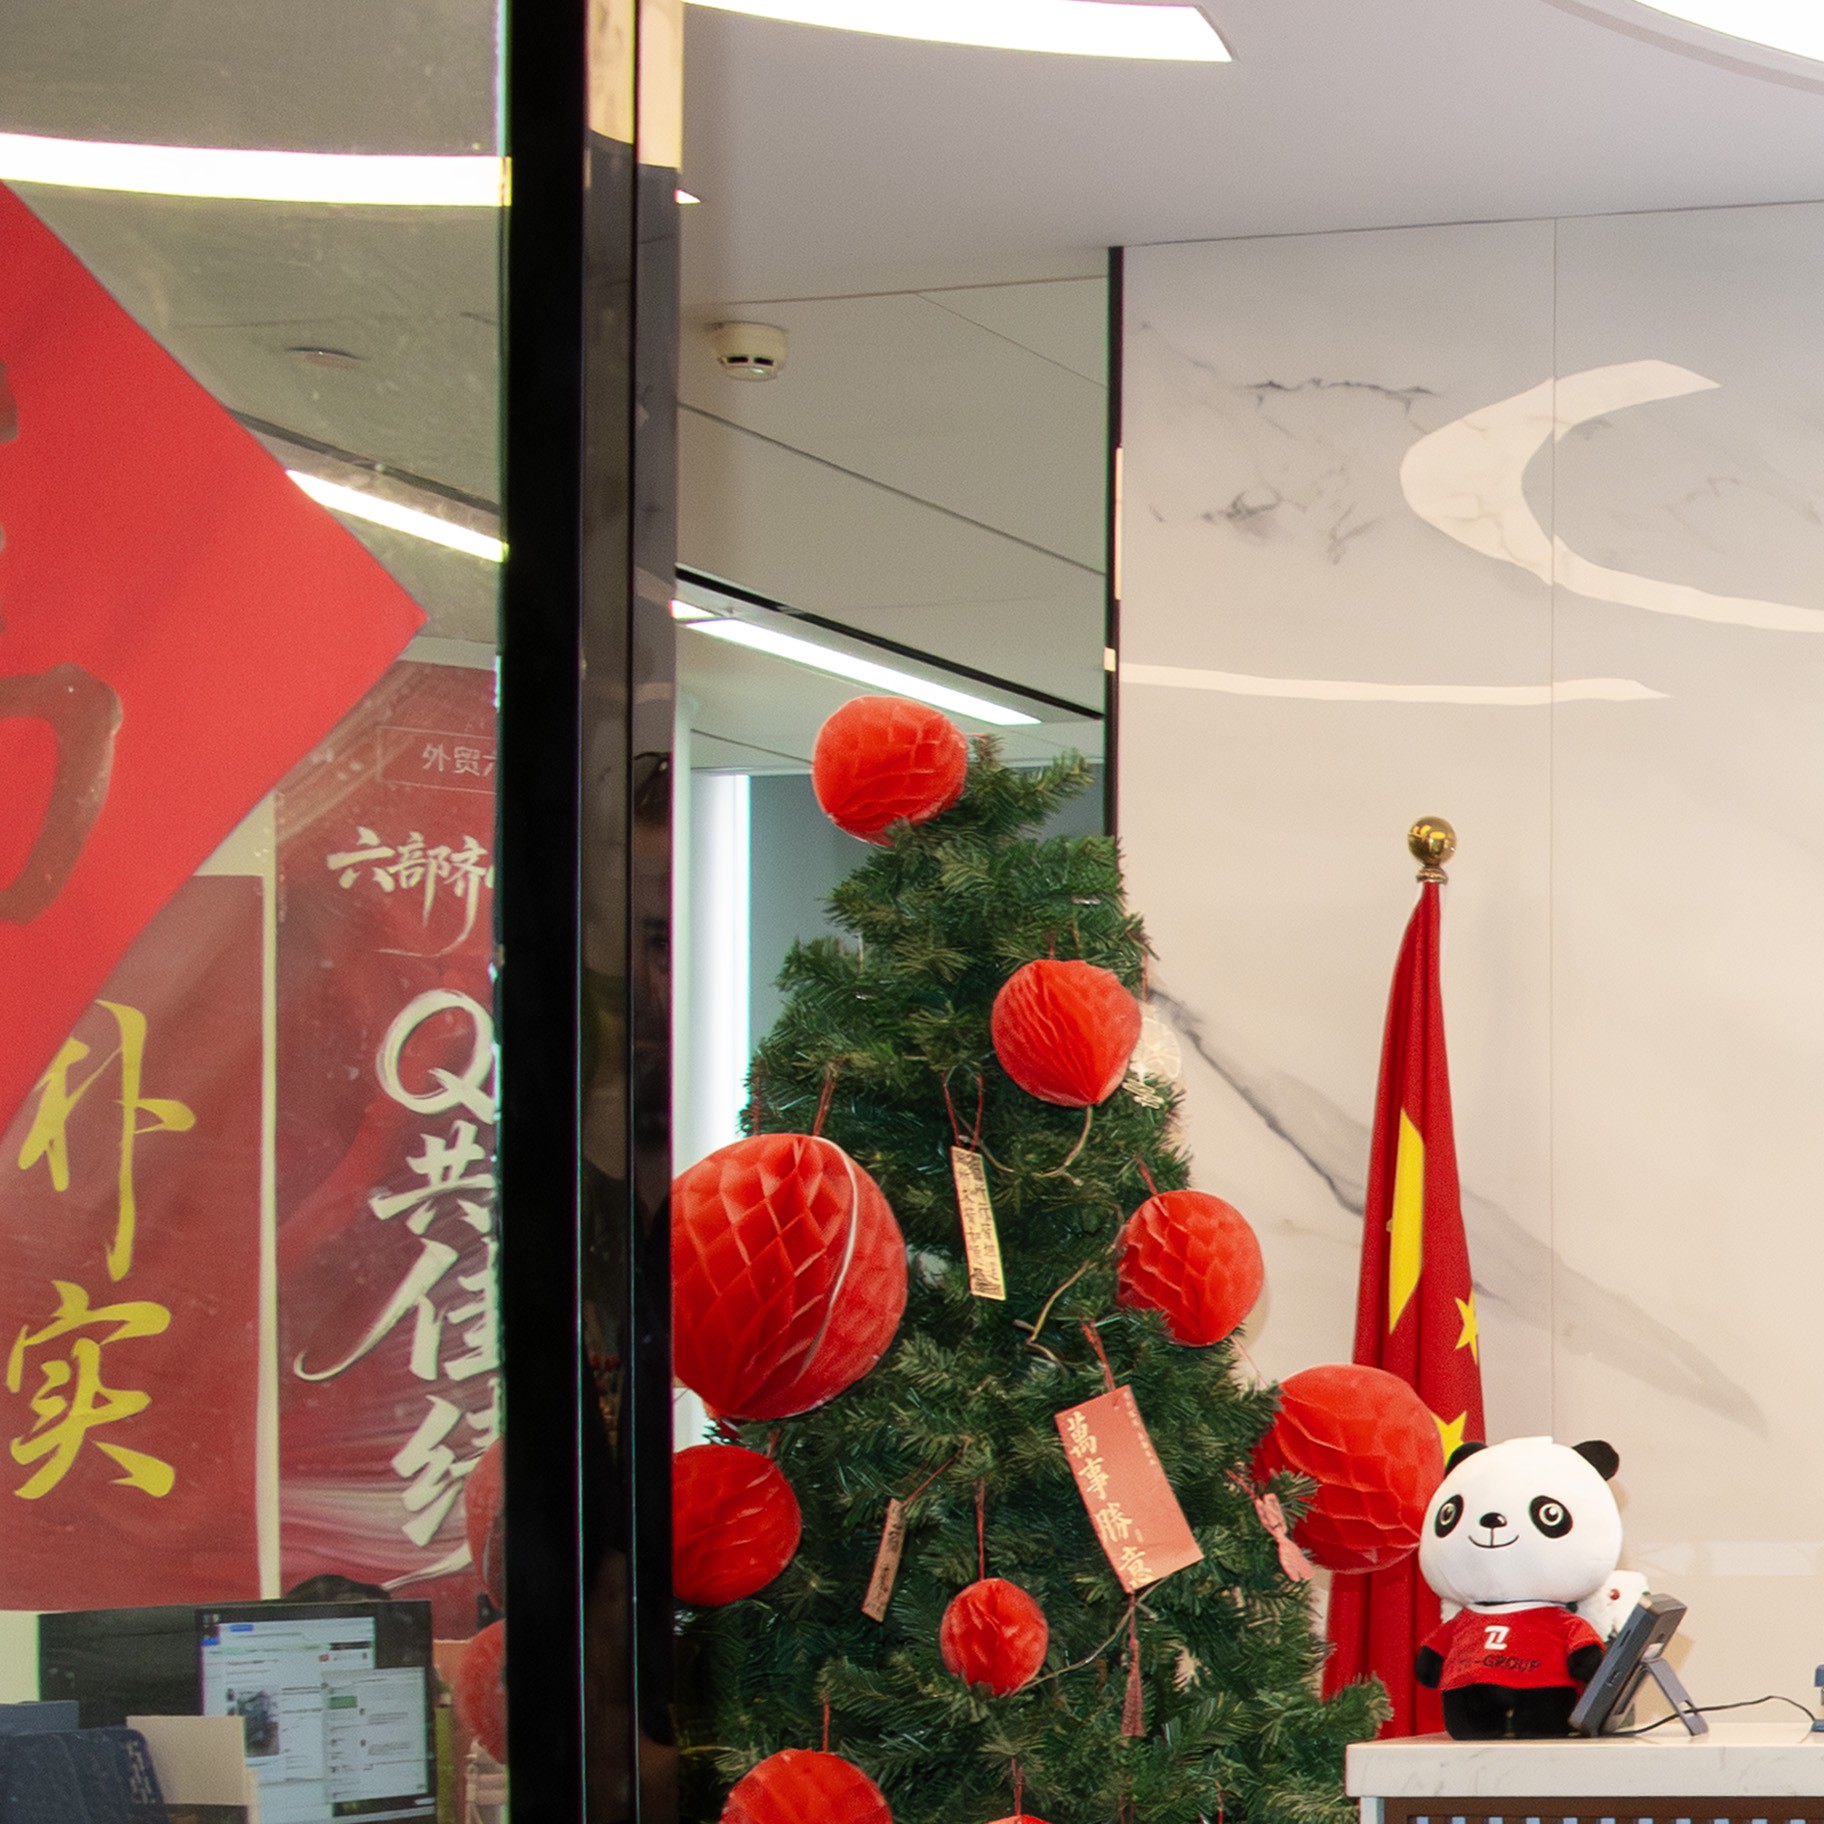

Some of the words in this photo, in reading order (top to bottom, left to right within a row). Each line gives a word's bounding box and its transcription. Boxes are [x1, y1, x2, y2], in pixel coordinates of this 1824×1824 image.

[328, 826, 495, 957] 六部齐
[1066, 1410, 1155, 1591] 萬事勝意
